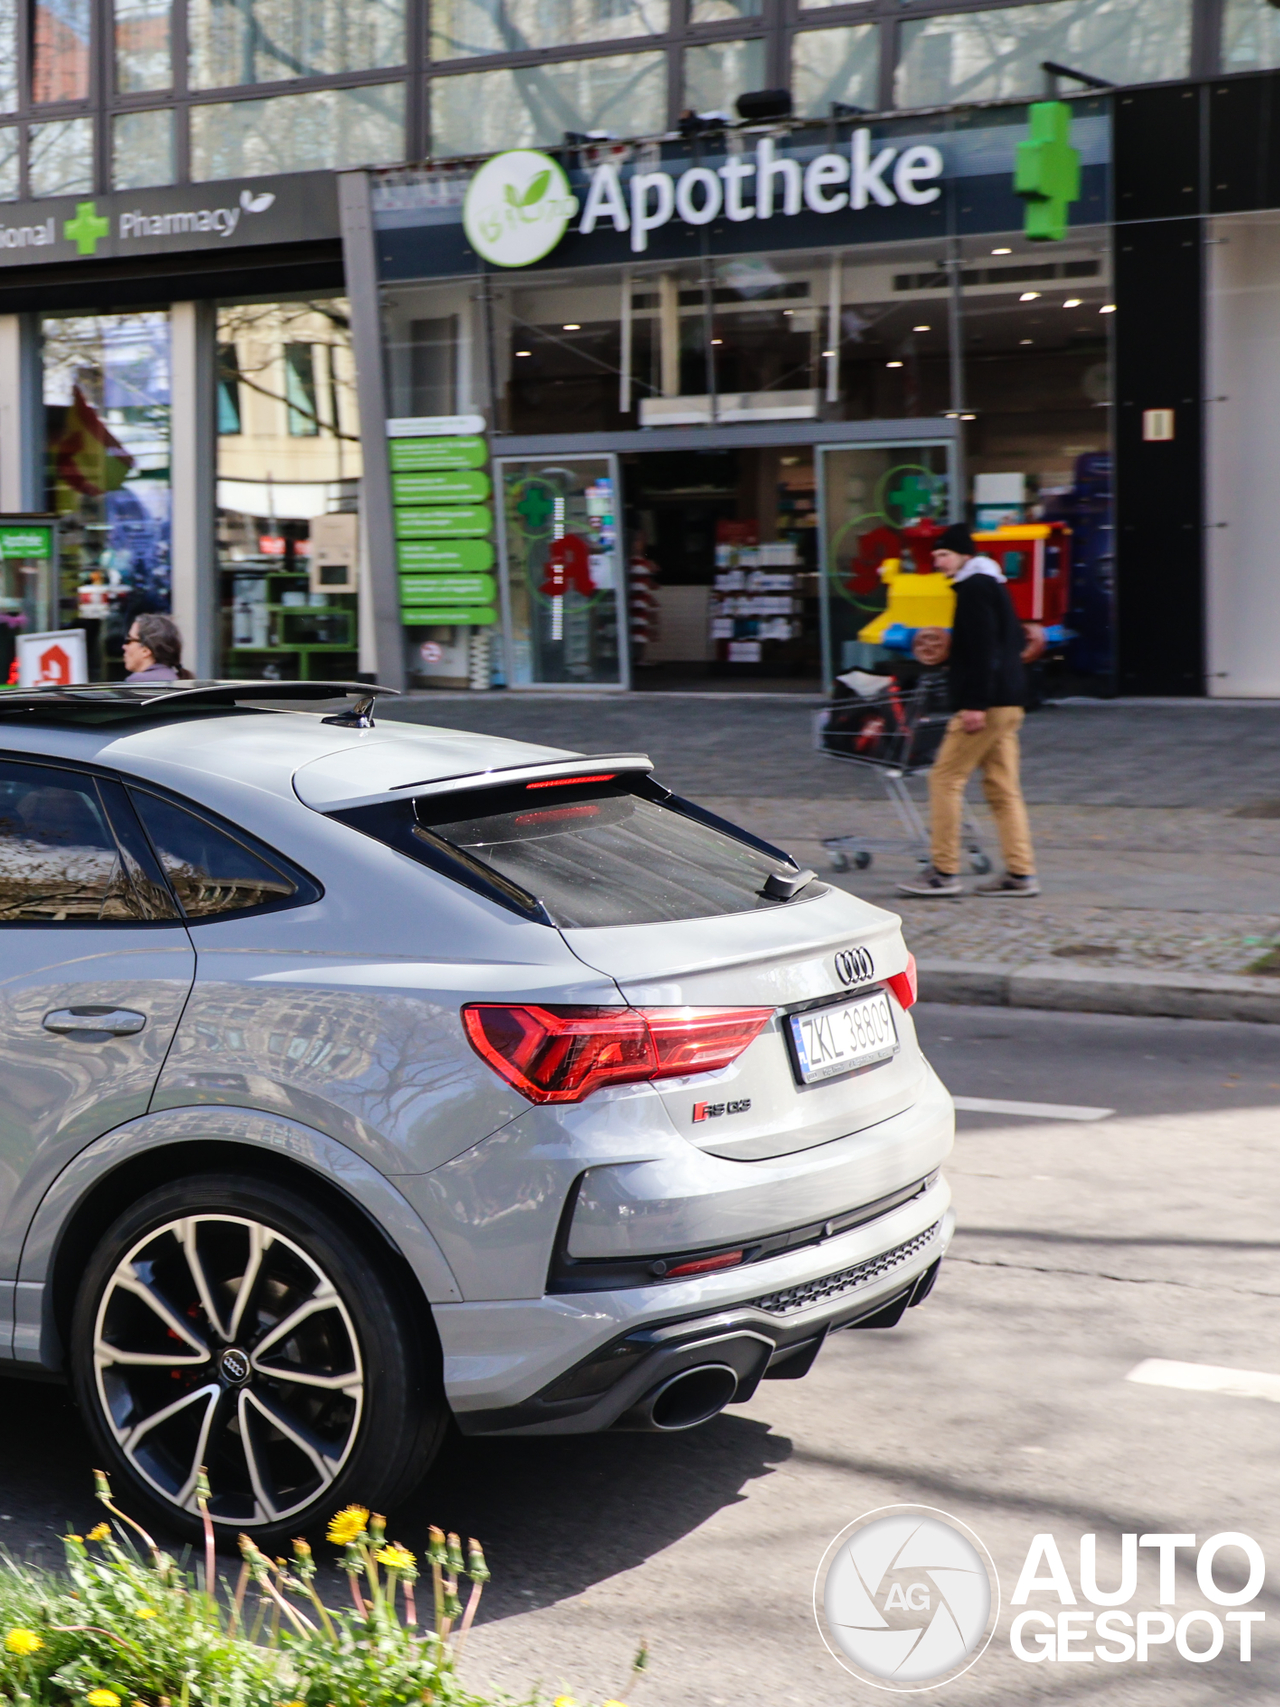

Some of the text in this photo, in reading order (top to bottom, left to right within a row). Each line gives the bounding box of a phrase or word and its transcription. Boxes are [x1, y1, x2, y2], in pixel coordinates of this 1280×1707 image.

[120, 204, 240, 240] Pharmacy
[579, 128, 943, 251] Apotheke
[802, 1015, 844, 1066] ZKL
[843, 1000, 889, 1052] 38809
